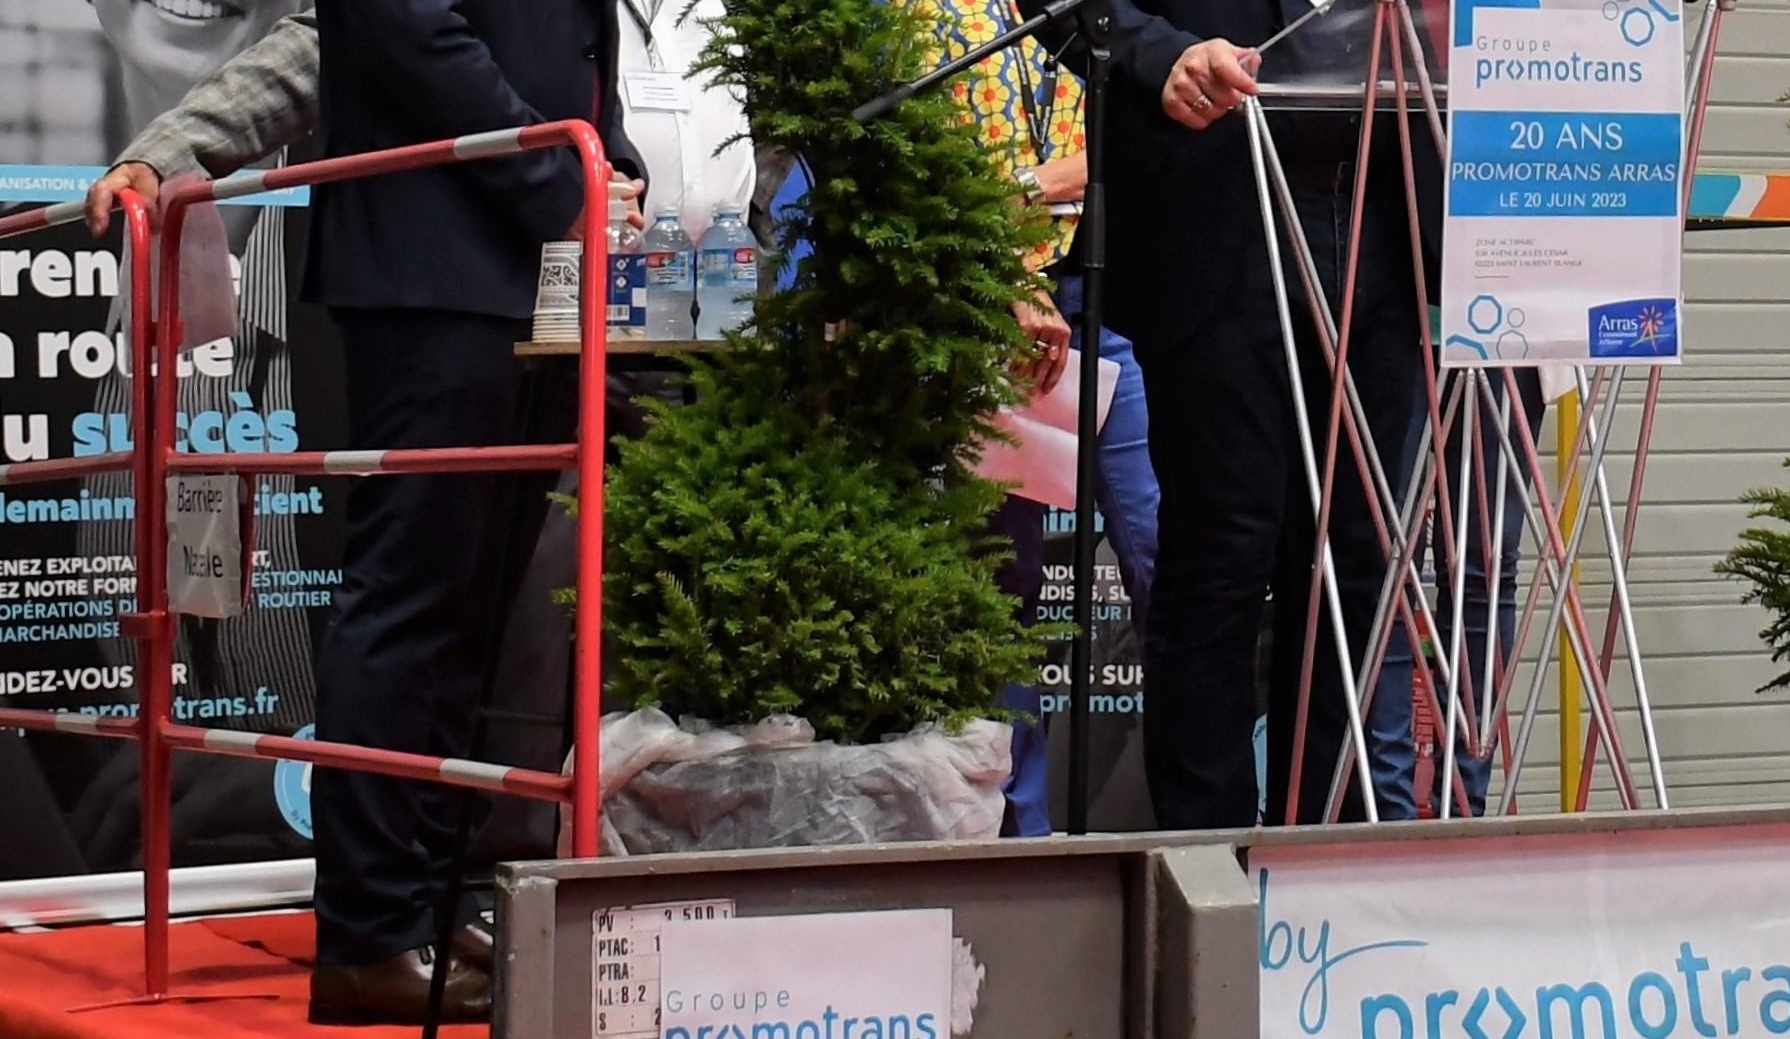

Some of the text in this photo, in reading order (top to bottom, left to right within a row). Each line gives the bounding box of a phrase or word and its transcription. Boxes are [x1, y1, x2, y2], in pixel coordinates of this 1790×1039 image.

[1476, 36, 1551, 53] Groupe
[1476, 52, 1643, 89] promotrans
[1510, 121, 1623, 151] 20 ANS
[1452, 162, 1676, 182] PROMOTRANS ARRAS
[0, 177, 75, 191] ANISATION
[1499, 192, 1627, 208] LE 20 JUIN 2023
[1598, 314, 1639, 331] Arras
[46, 556, 137, 575] EXPLOITA
[25, 579, 89, 598] NOTRE
[251, 569, 343, 588] ESTIONNAI
[259, 590, 332, 609] ROUTIER
[0, 621, 121, 643] ARCHANDISE
[598, 914, 614, 933] PV
[666, 989, 791, 1015] Groupe
